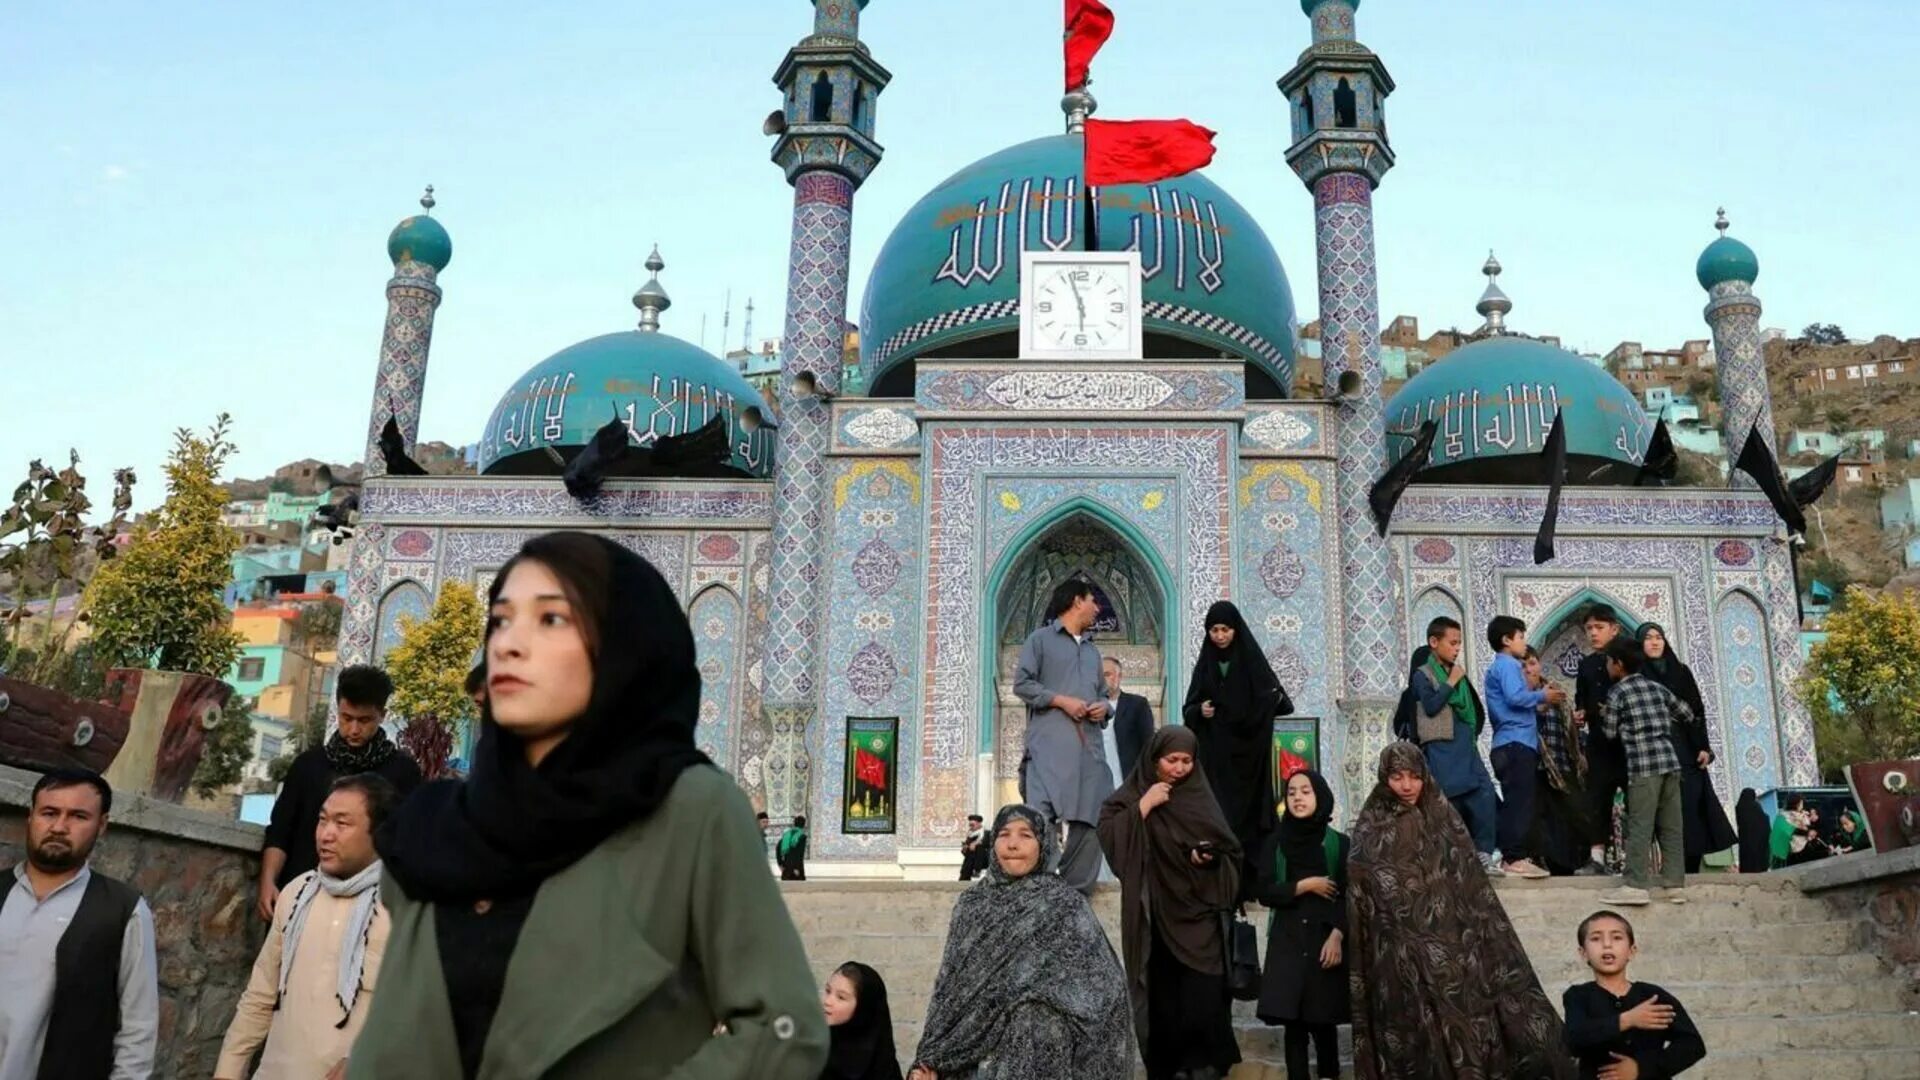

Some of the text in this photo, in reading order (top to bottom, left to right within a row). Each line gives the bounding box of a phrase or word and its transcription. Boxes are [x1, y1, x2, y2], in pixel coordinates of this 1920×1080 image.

[1070, 270, 1090, 281] 12
[1039, 301, 1053, 314] 9
[1110, 302, 1124, 313] 3
[1074, 333, 1088, 346] 6
